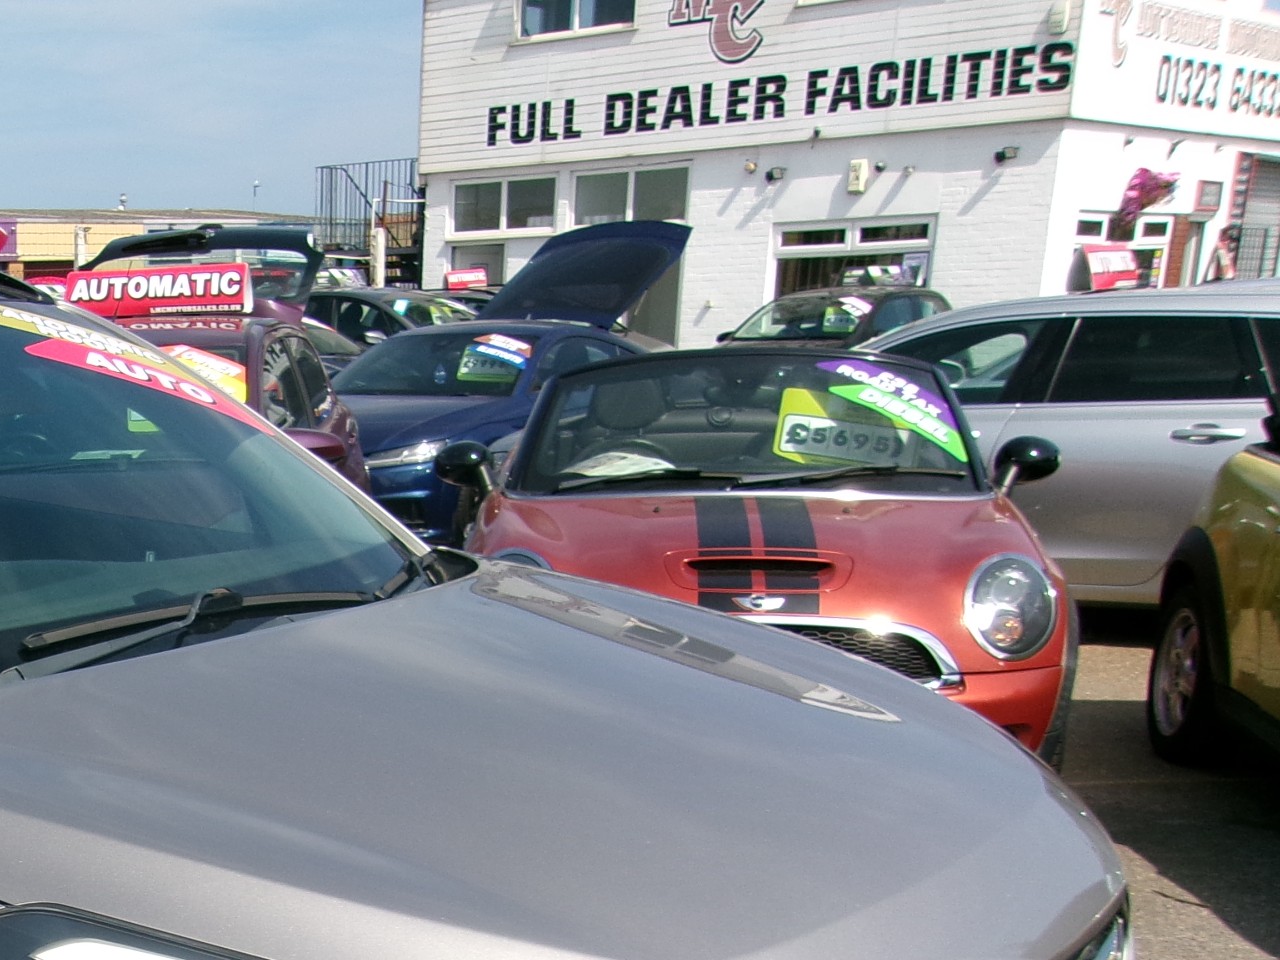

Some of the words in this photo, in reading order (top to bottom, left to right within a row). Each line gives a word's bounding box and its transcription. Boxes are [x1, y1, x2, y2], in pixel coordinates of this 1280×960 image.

[486, 98, 582, 147] FULL
[603, 74, 787, 136] DEALER
[804, 41, 1074, 116] FACILITIES
[1155, 54, 1222, 111] 01323
[1228, 67, 1280, 118] 6433
[70, 271, 241, 302] AUTOMATIC
[86, 351, 216, 404] AUTO
[901, 389, 943, 418] TAX
[784, 422, 890, 454] £5695
[856, 387, 949, 443] DIESEL
